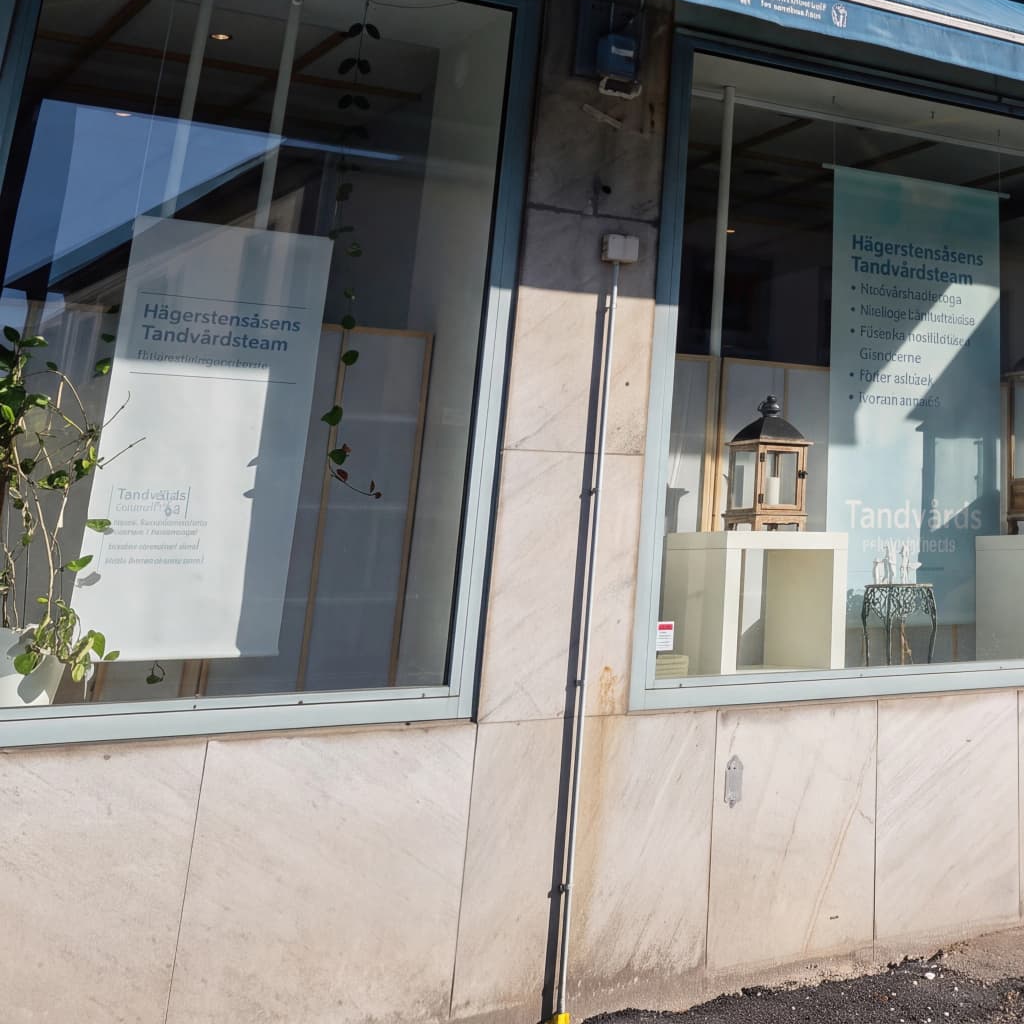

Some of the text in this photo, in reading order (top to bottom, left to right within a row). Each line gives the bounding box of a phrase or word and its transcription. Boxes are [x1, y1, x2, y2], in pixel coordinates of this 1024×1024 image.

[851, 234, 984, 267] Hägerstensåsens
[851, 255, 973, 286] Tandvårdsteam
[143, 303, 302, 333] Hägerstensåsens
[141, 324, 289, 352] Tandvårdsteam
[845, 499, 983, 530] Tandvårds
